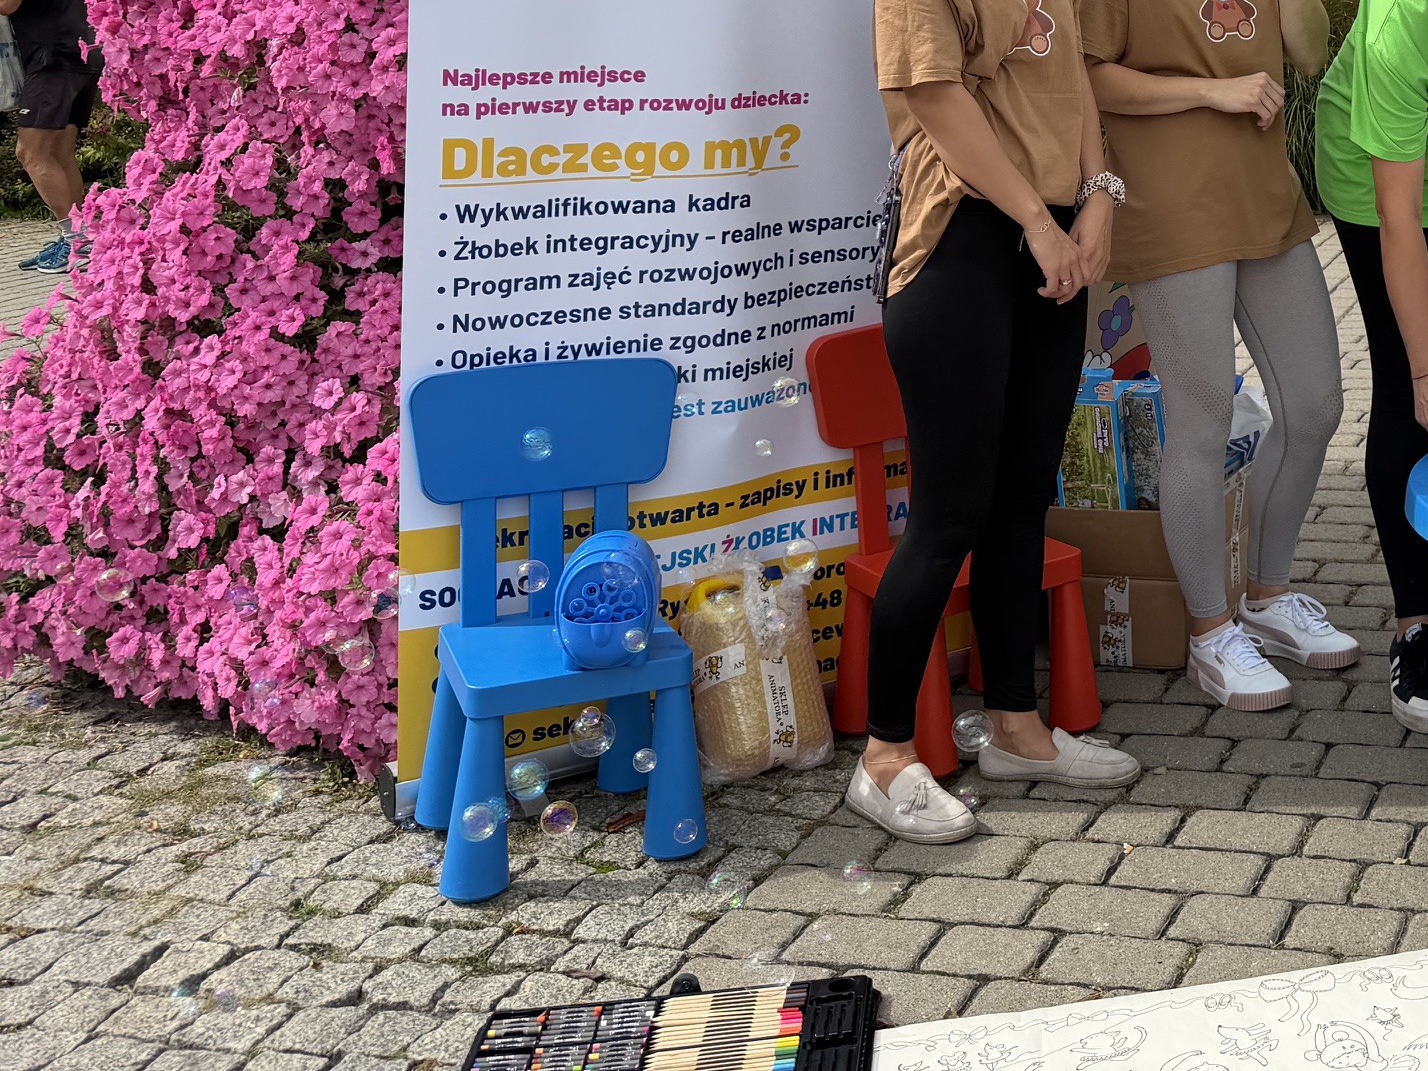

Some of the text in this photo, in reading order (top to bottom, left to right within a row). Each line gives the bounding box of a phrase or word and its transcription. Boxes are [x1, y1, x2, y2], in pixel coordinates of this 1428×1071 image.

[442, 65, 646, 91] Najlepsze miejsce
[441, 89, 810, 120] na pierwszy etap rozwoju dziecka:
[441, 123, 802, 183] Dlaczego my?
[455, 191, 752, 228] Wykwalifikowana kadra
[452, 235, 540, 262] Żłobek
[545, 228, 700, 256] integracyjny
[720, 219, 784, 246] realne
[788, 209, 883, 238] wsparcie
[452, 243, 882, 300] Program zajęć rozwojowych i sensory
[452, 272, 874, 334] Nowoczesne standardy bezpieczeńst
[451, 304, 856, 370] Opieka i żywienie zgodne z normami
[703, 347, 794, 382] miejskiej
[739, 477, 808, 510] zapisy
[813, 471, 820, 491] i
